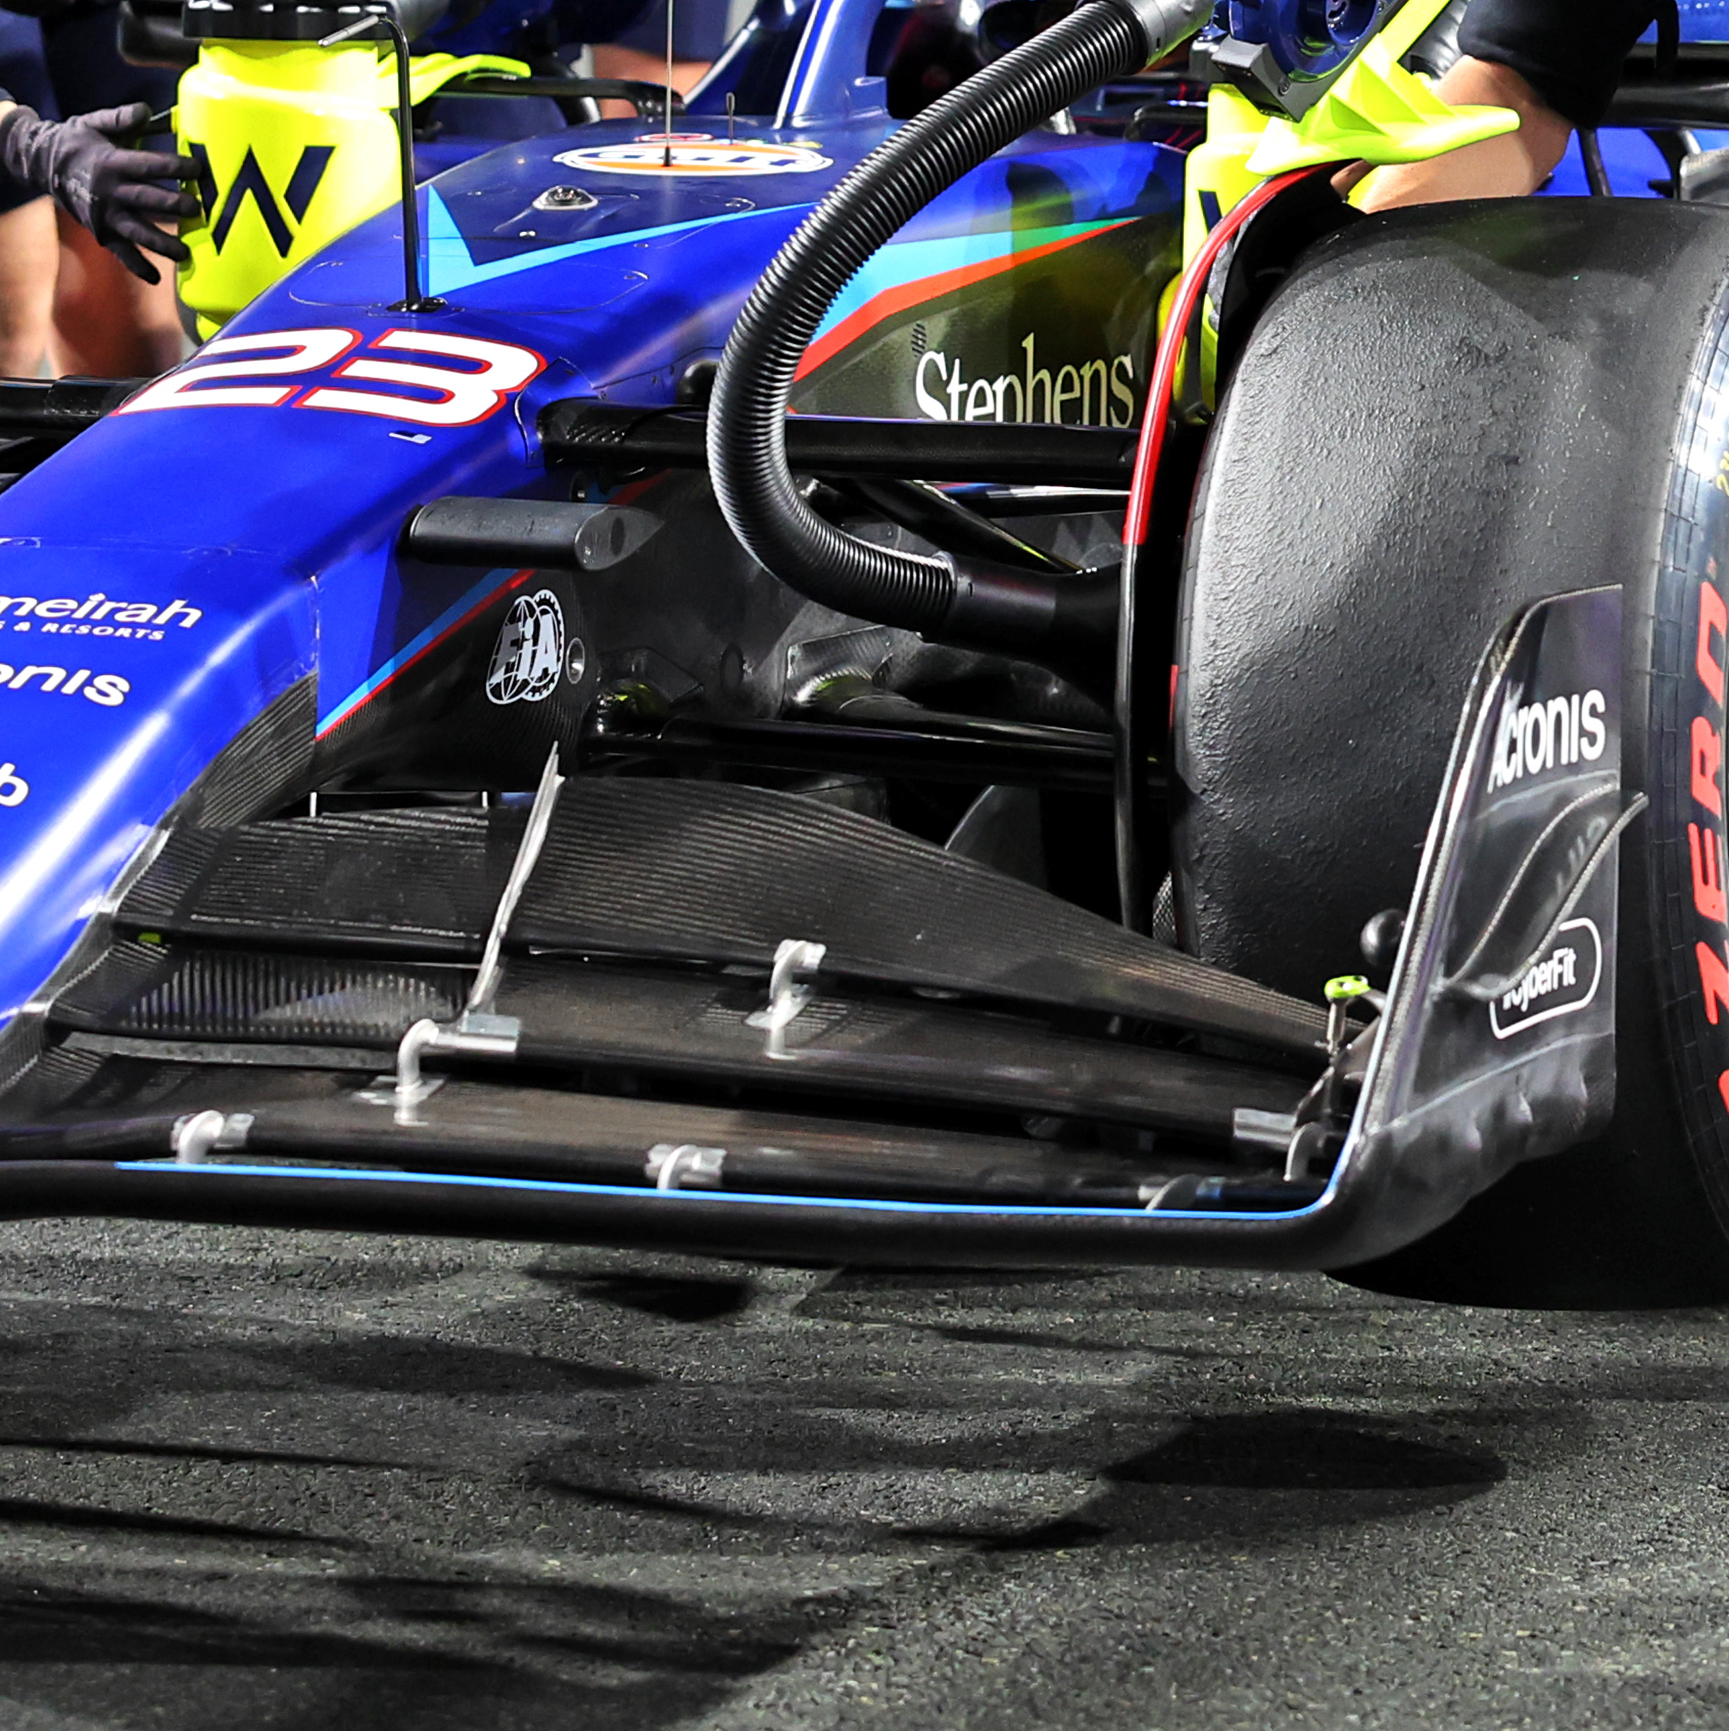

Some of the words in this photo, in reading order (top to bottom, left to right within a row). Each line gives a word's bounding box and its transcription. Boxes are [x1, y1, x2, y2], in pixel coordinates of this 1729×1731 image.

[110, 327, 548, 427] 23
[13, 620, 32, 633] &
[40, 622, 166, 641] RESORTS
[1487, 689, 1606, 794] Acronis
